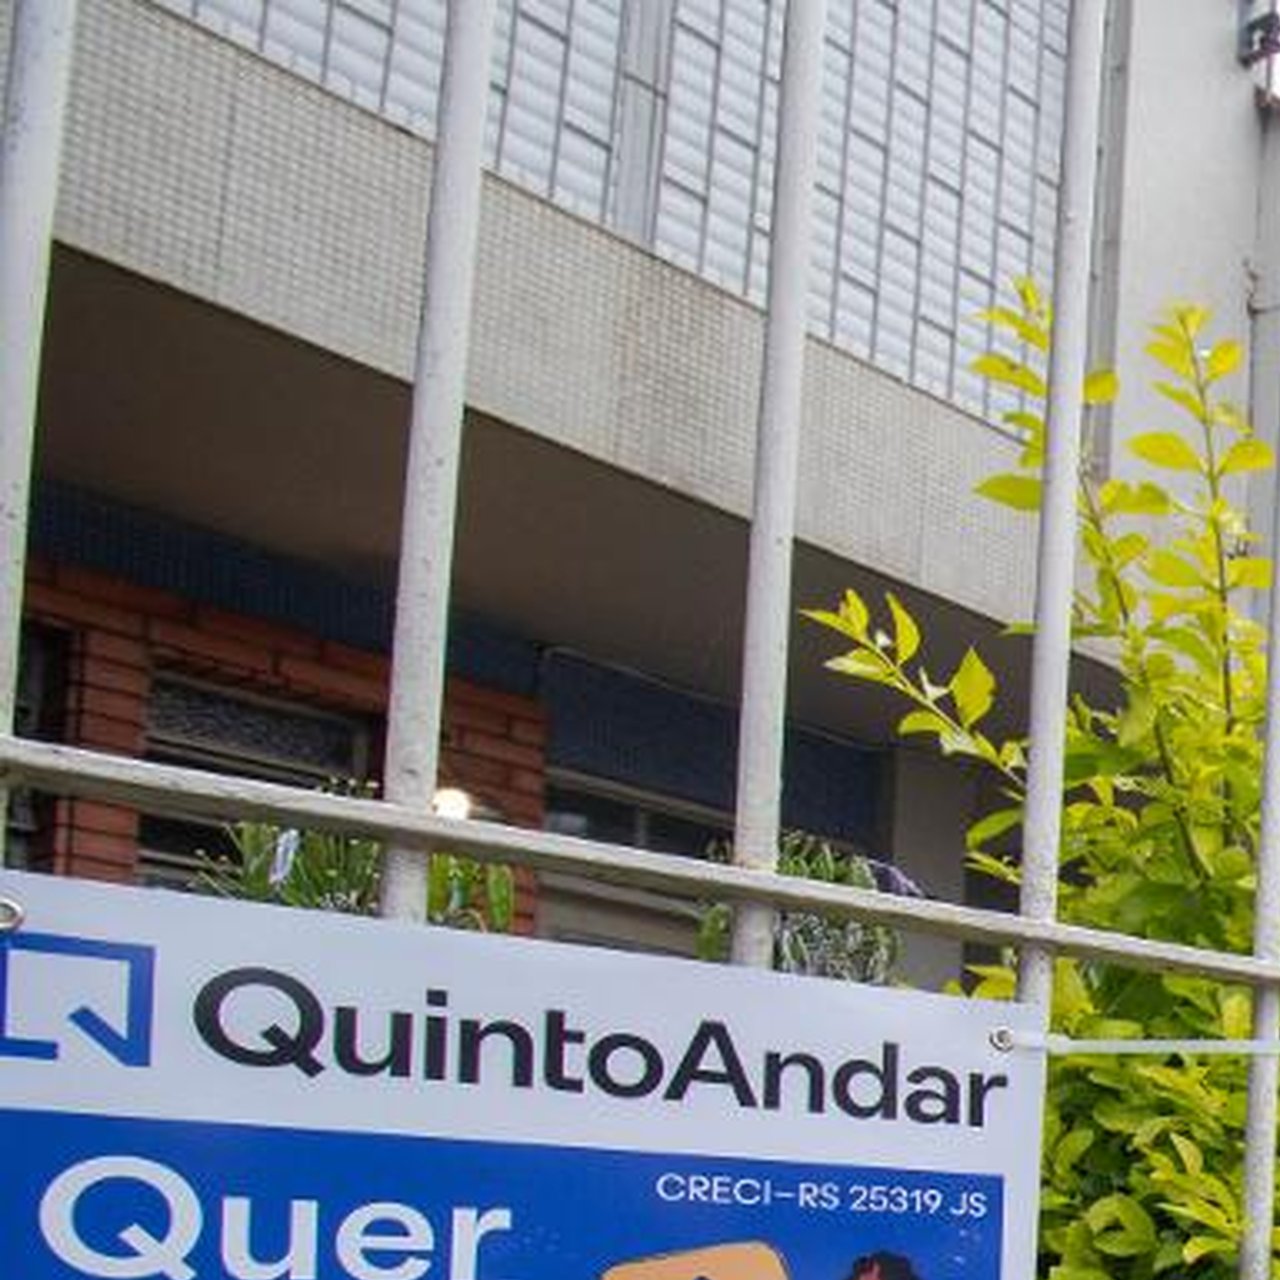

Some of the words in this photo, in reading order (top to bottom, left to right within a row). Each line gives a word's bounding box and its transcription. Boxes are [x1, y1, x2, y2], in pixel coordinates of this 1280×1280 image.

[193, 968, 1008, 1127] QuintoAndar
[656, 1173, 840, 1209] CRECI-RS
[849, 1185, 943, 1214] 25319
[951, 1192, 987, 1217] JS
